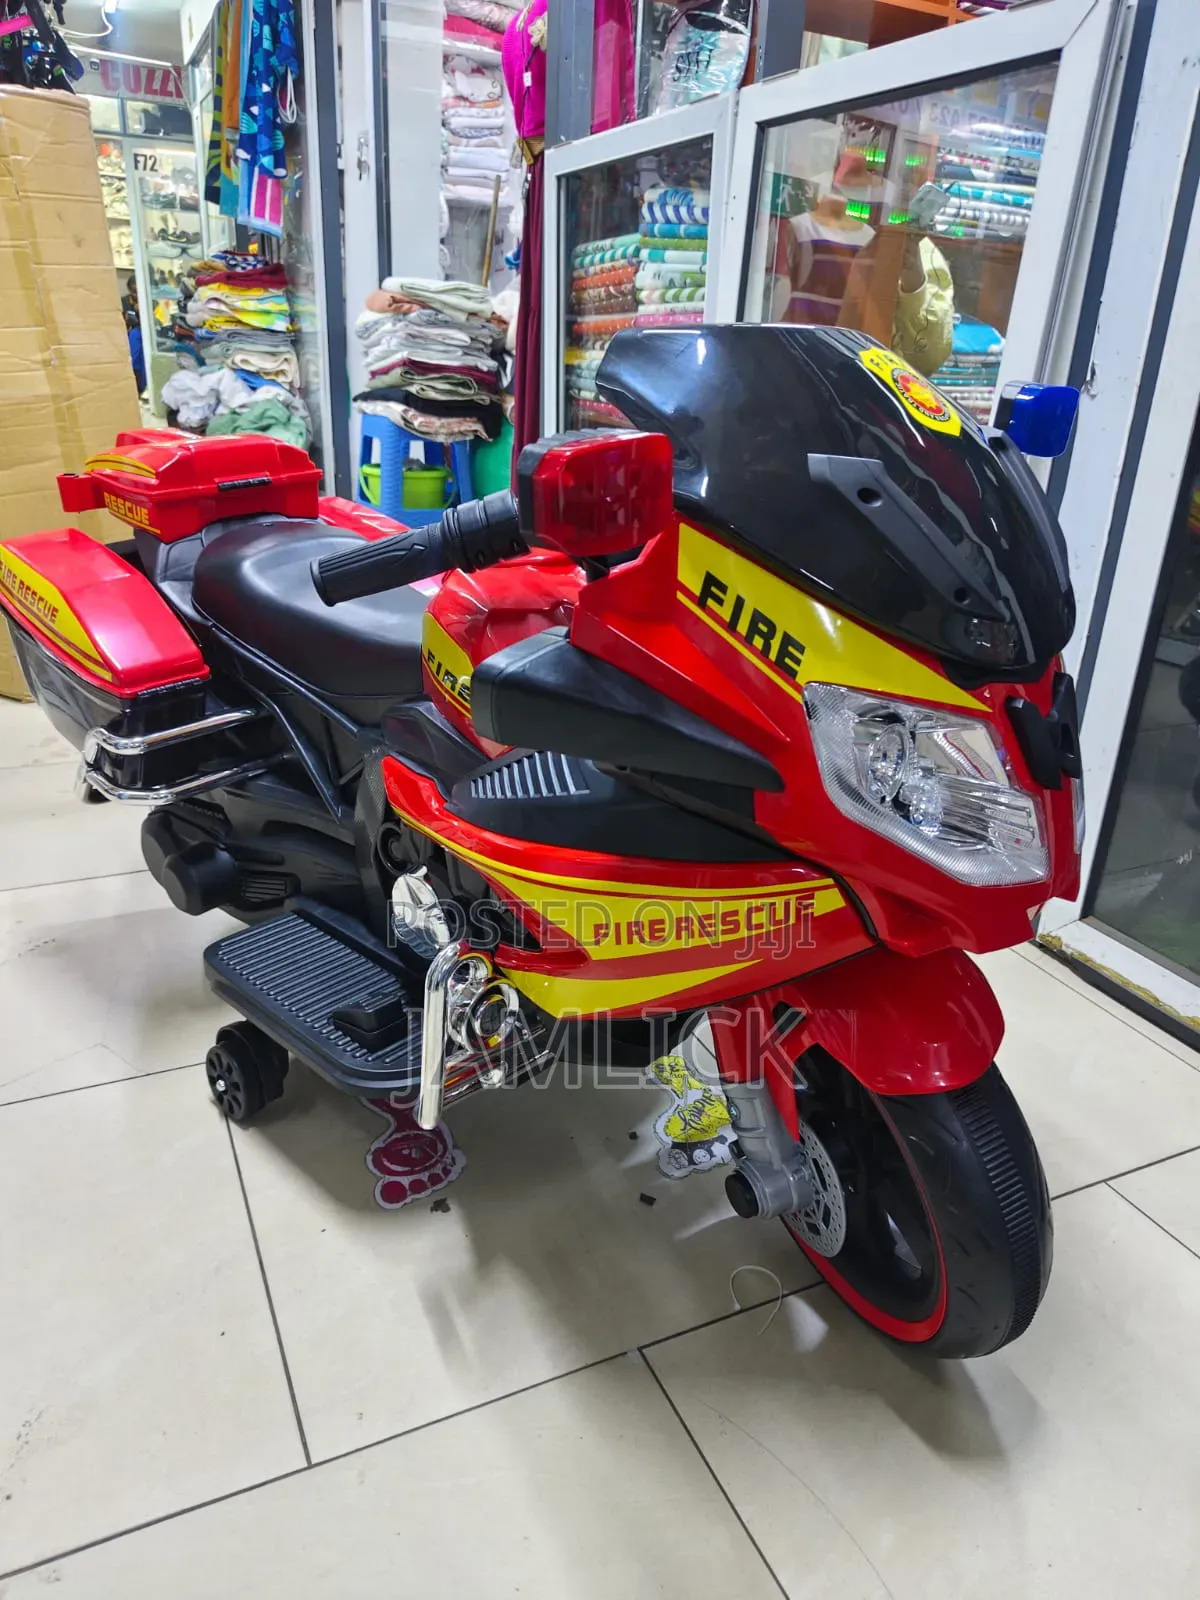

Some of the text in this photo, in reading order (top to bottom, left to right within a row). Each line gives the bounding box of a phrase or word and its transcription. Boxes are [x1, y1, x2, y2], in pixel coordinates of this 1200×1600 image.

[133, 152, 159, 173] F72
[103, 491, 149, 526] RESCUE
[17, 578, 59, 624] RESCUE
[697, 570, 806, 681] FIRE
[427, 647, 471, 702] FIRE
[593, 893, 815, 946] FIRE RESCUE
